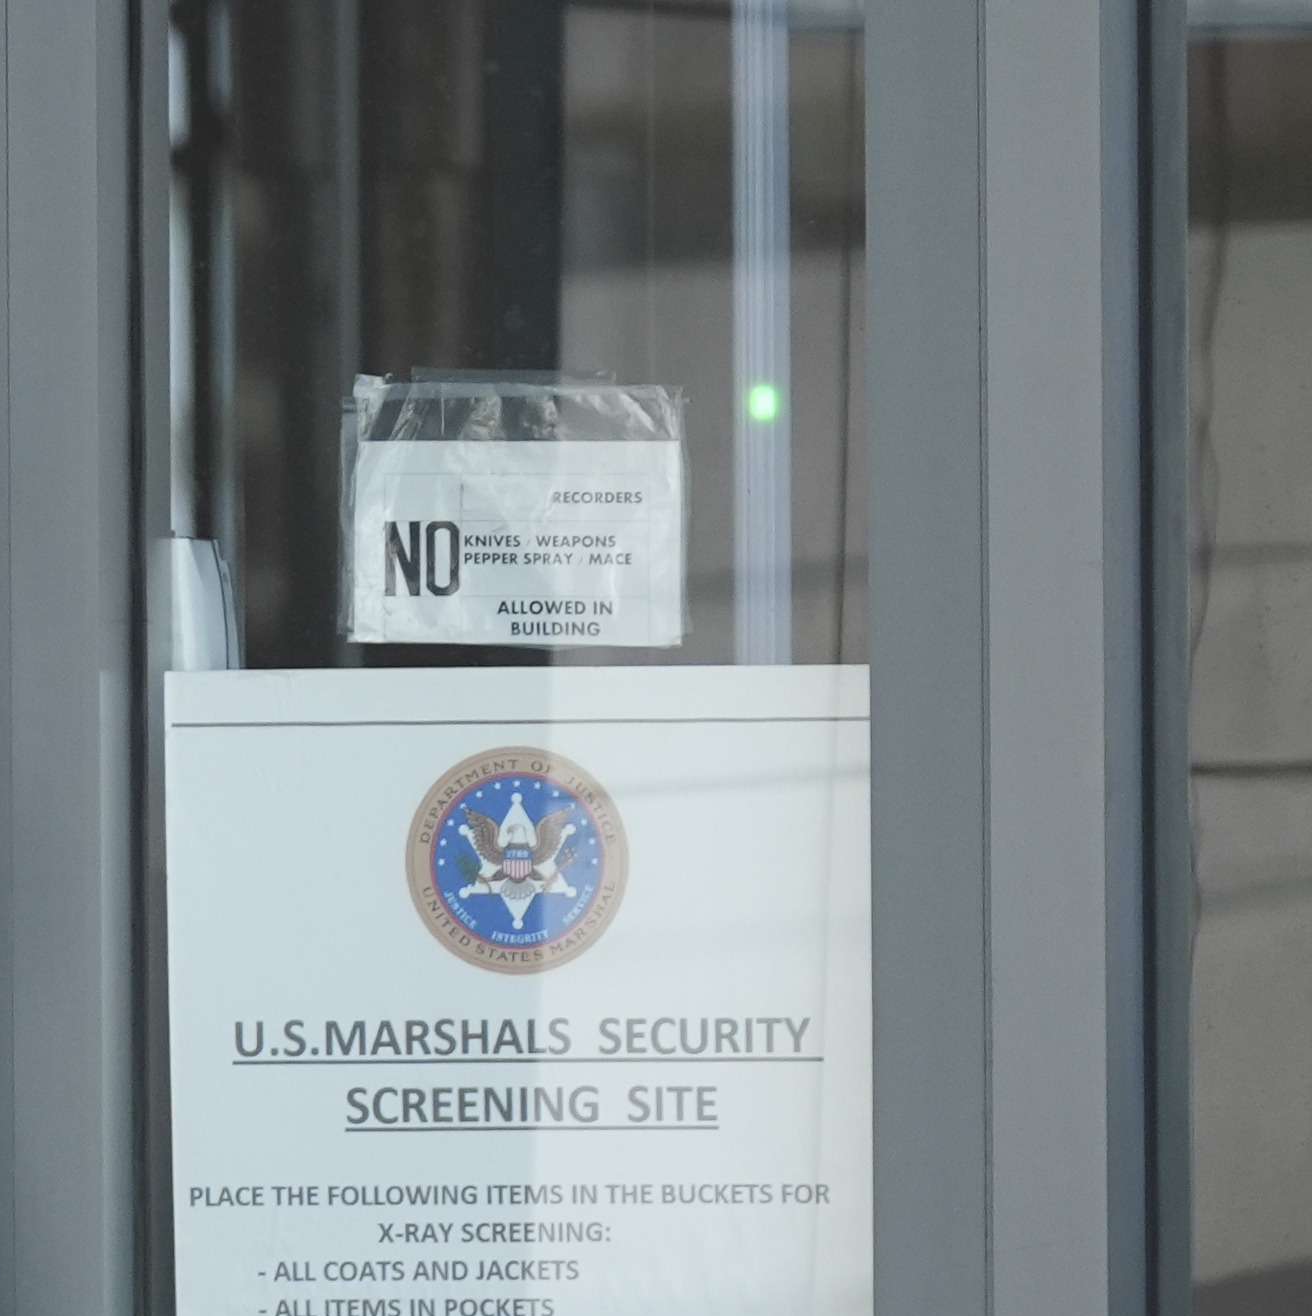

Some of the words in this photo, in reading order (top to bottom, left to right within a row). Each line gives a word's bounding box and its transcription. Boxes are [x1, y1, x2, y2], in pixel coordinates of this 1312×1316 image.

[553, 492, 642, 503] RECORDERS
[465, 535, 520, 547] KNIVES
[536, 536, 616, 548] WEAPONS
[384, 521, 460, 596] NO
[464, 553, 517, 564] PEPPER
[524, 553, 572, 565] SPRAY
[589, 553, 631, 565] MACE
[497, 601, 586, 615] ALLOWED
[594, 601, 612, 615] IN
[511, 622, 600, 636] BUILDING
[420, 759, 519, 845] DEPARTMENT
[531, 760, 553, 774] OF
[564, 776, 617, 845] JUSTICE
[423, 886, 472, 948] UNITED
[475, 943, 544, 963] STATES
[550, 882, 616, 956] MARSHAL
[443, 891, 478, 930] JUSTICE
[491, 929, 549, 944] INTEGRITY
[235, 1018, 572, 1057] U.S.MARSHALS
[599, 1017, 812, 1055] SECURITY
[346, 1086, 601, 1125] SCREENING
[628, 1086, 718, 1123] SITE
[190, 1187, 264, 1206] PLACE
[271, 1186, 319, 1206] THE
[328, 1185, 477, 1205] FOLLOWING
[487, 1185, 563, 1205] ITEMS
[572, 1185, 597, 1204] IN
[605, 1184, 653, 1204] THE
[662, 1184, 773, 1204] BUCKETS
[782, 1184, 830, 1204] FOR
[378, 1223, 453, 1243] X-RAY
[461, 1222, 610, 1243] SCREENING:
[274, 1261, 316, 1282] ALL
[324, 1261, 405, 1281] COATS
[413, 1261, 468, 1281] AND
[476, 1260, 578, 1280] JACKETS
